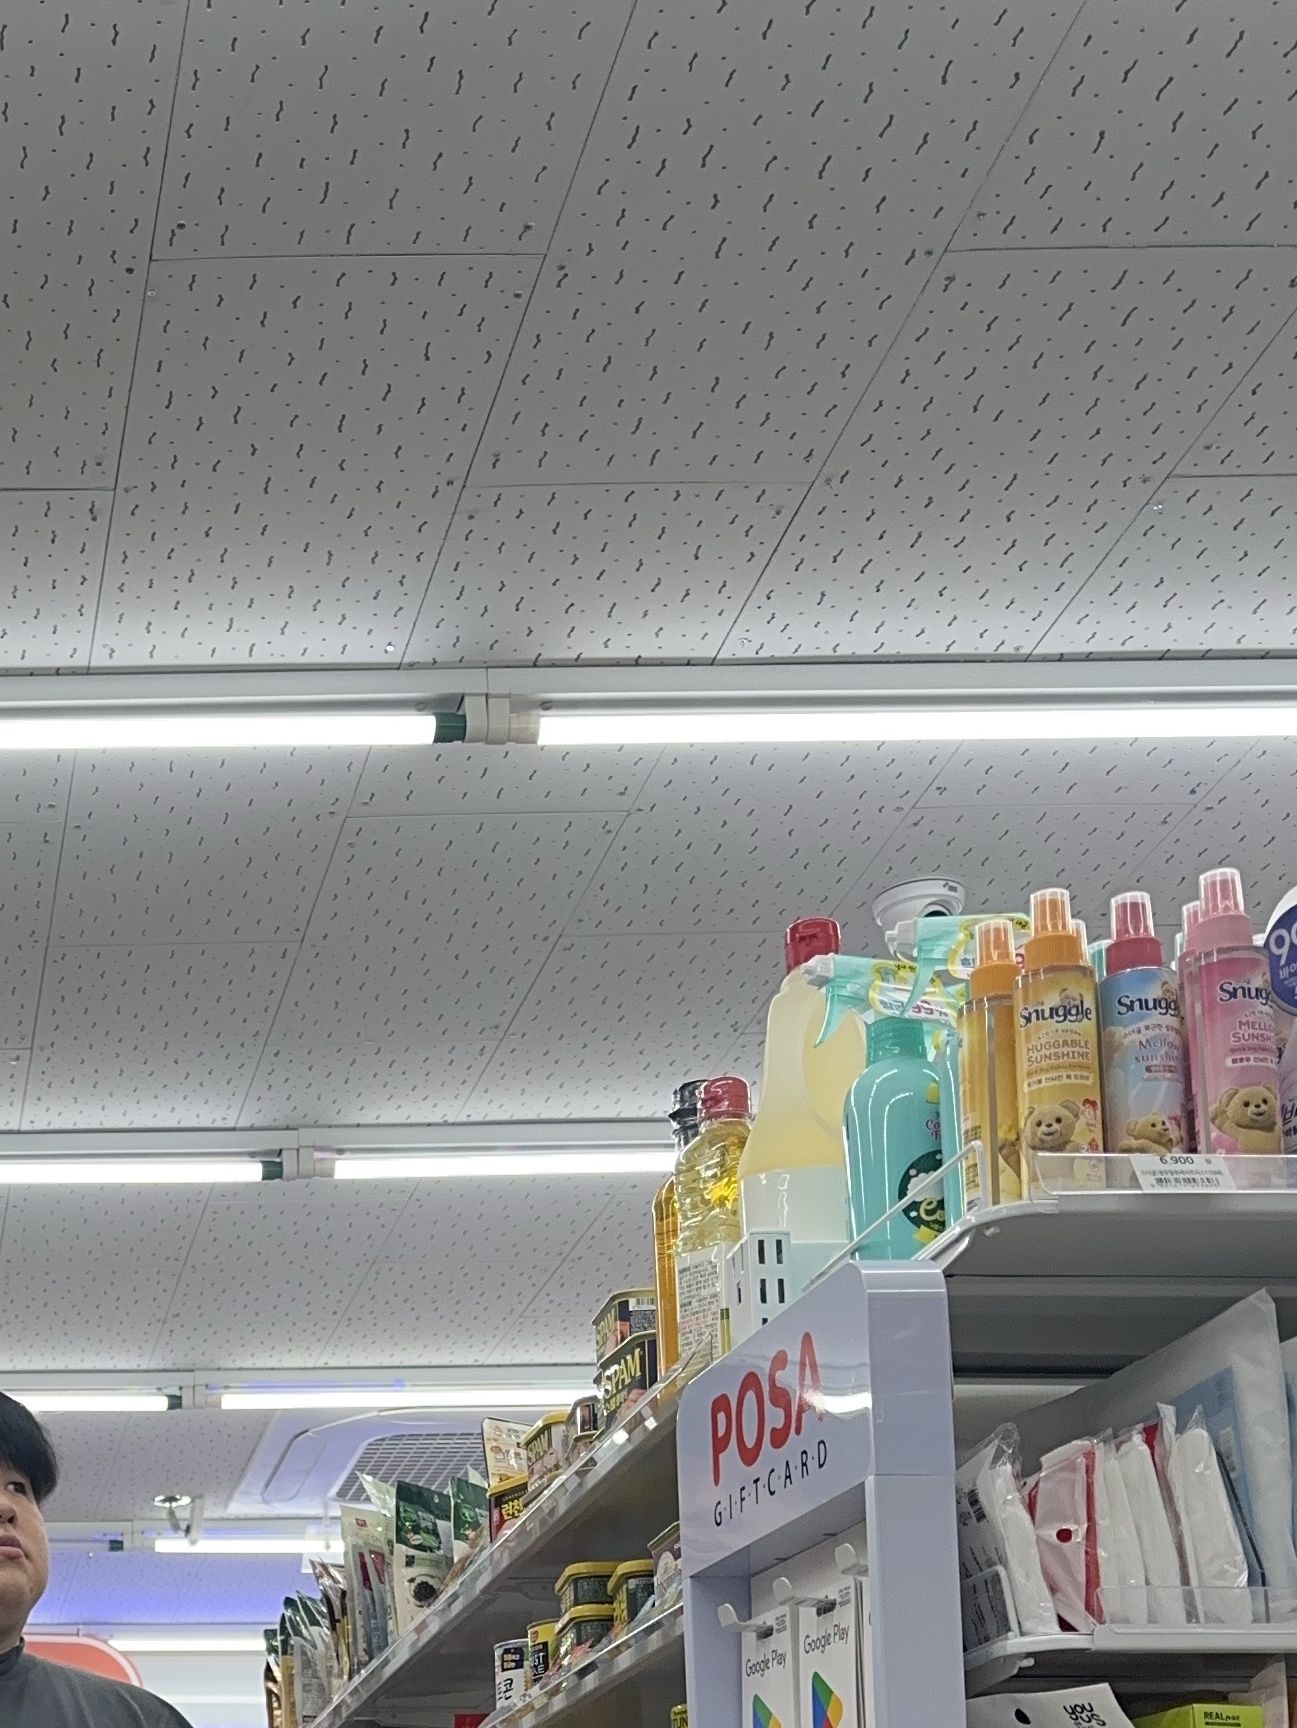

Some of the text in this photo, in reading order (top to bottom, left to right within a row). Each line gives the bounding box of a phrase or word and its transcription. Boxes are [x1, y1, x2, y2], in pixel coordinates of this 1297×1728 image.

[1019, 999, 1093, 1028] Snuggle
[1237, 1019, 1275, 1033] MELLO
[1026, 1039, 1091, 1056] HUGGABLE
[1027, 1051, 1092, 1068] SUNSHINE
[1160, 1156, 1194, 1166] 6,900
[604, 1347, 643, 1400] SPAM
[711, 1331, 826, 1487] POSA
[804, 1623, 849, 1654] Google Play
[745, 1649, 787, 1678] Google Play
[1204, 1711, 1225, 1721] REAL
